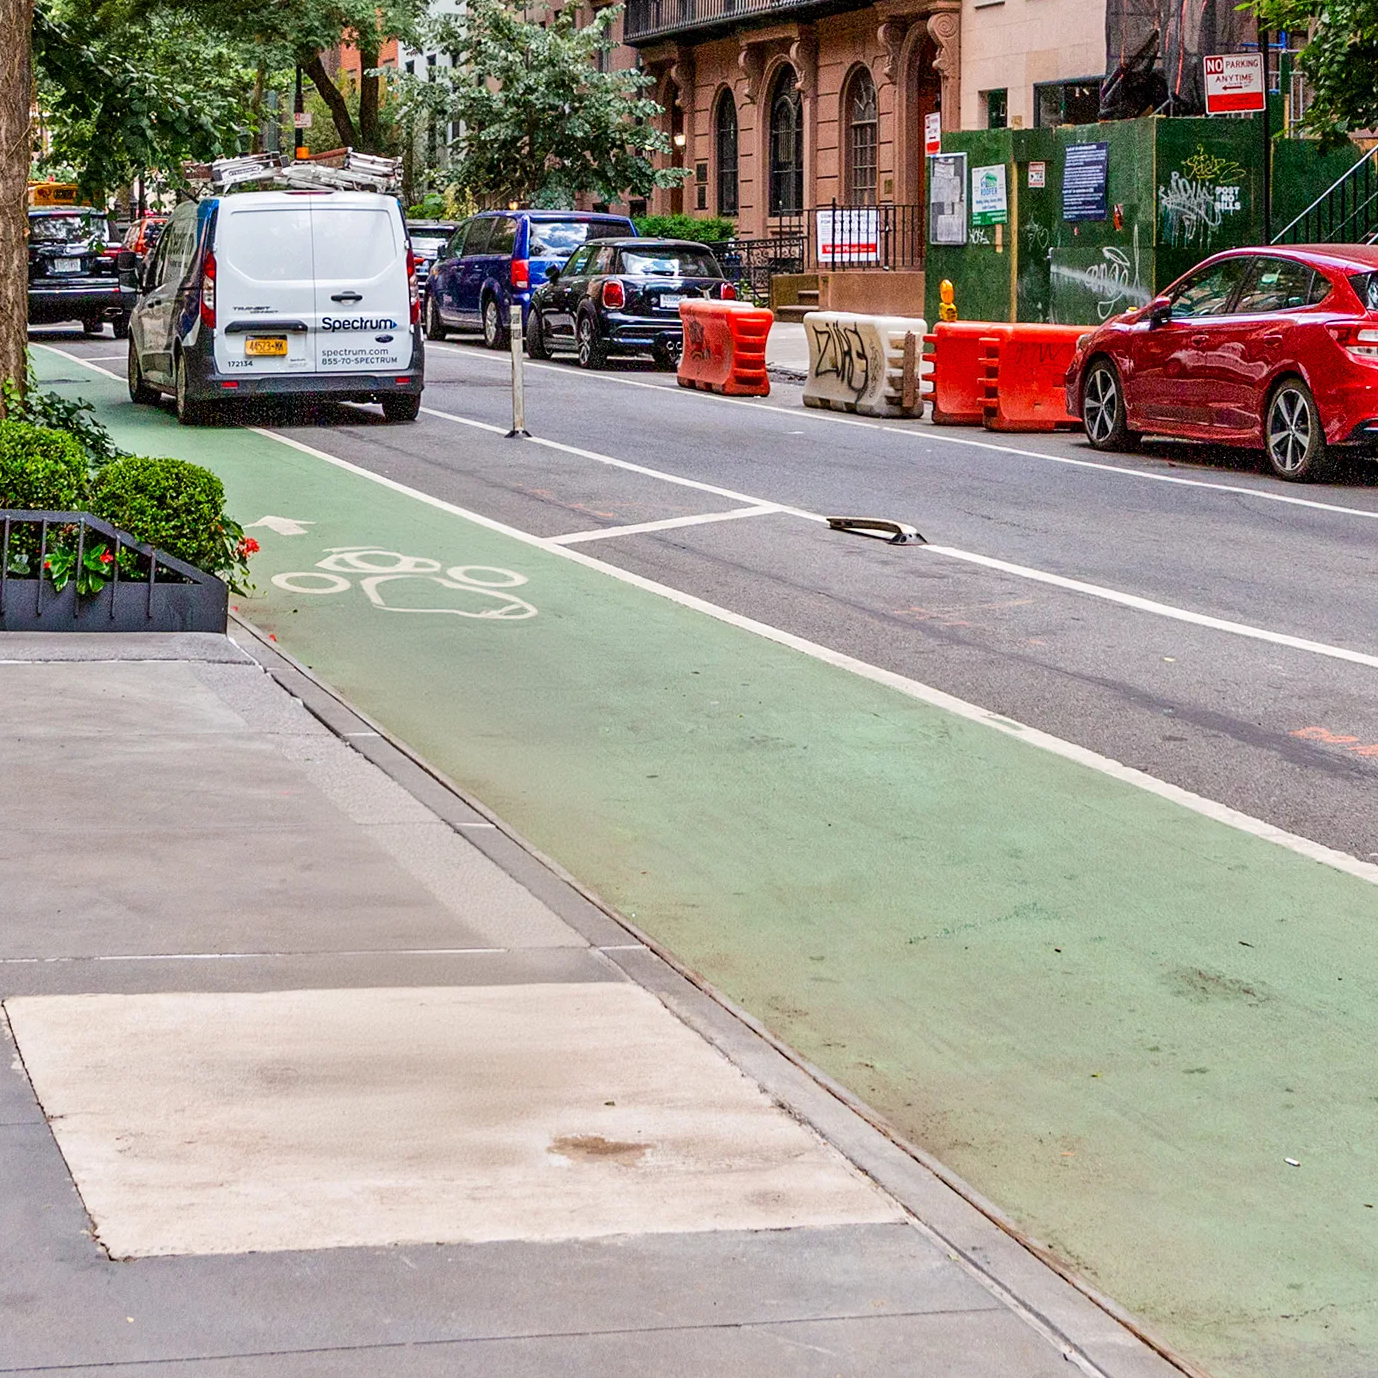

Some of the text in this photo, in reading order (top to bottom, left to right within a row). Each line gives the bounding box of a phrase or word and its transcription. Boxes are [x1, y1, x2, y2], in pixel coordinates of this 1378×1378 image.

[1206, 59, 1259, 73] NO PARKING
[1215, 73, 1254, 83] ANYTIME
[1214, 186, 1240, 195] POST
[1221, 194, 1236, 203] NO
[1214, 201, 1241, 211] BILLS
[321, 317, 393, 333] Spectrum
[321, 349, 389, 357] spectrum.com
[321, 357, 398, 365] 855-70-SPECTRUM
